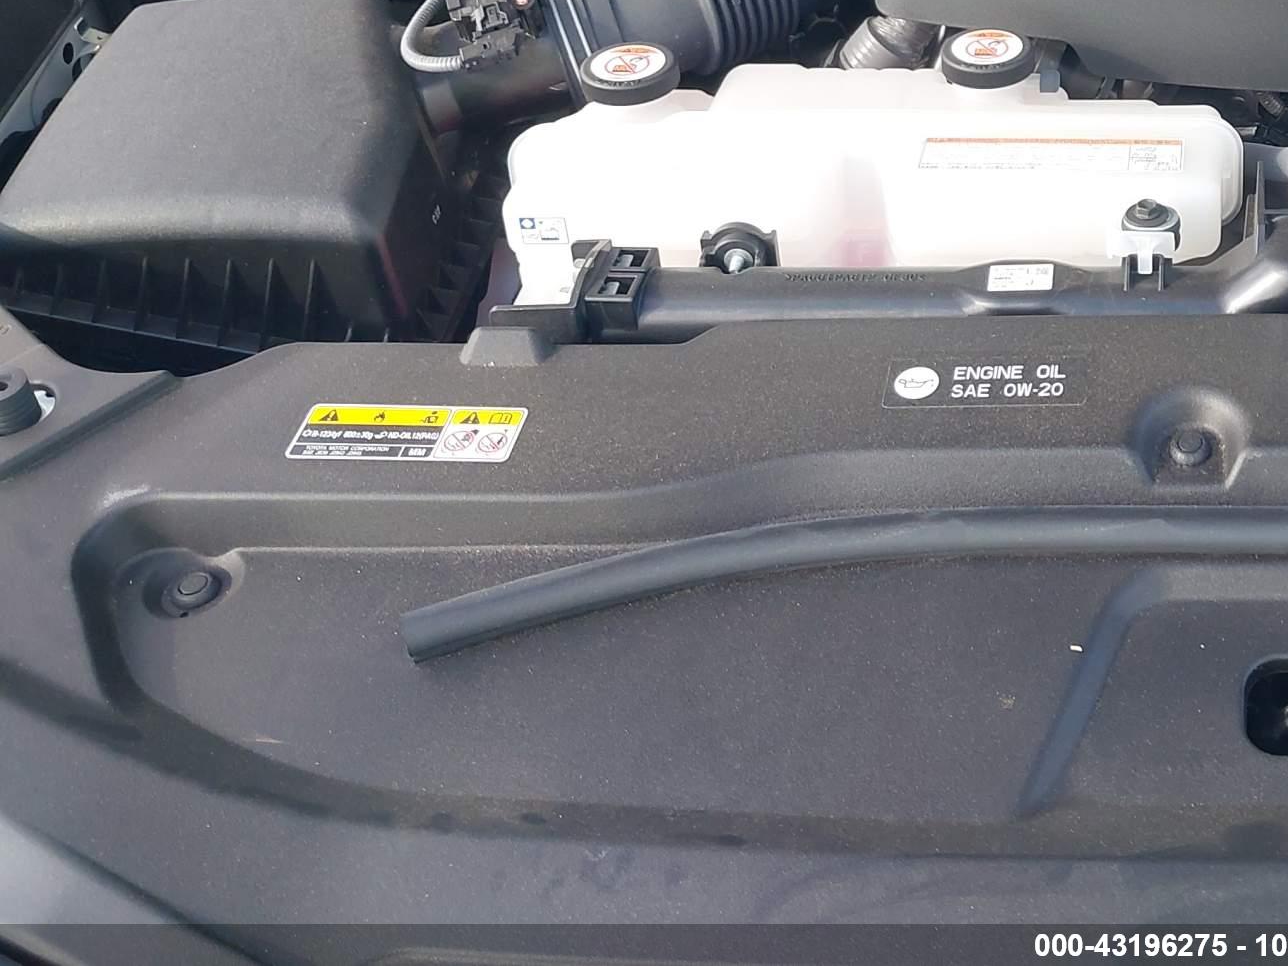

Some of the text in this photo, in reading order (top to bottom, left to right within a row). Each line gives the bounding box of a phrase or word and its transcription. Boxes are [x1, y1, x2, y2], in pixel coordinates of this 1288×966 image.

[953, 364, 1066, 381] ENGINE OIL
[951, 383, 991, 398] SAE
